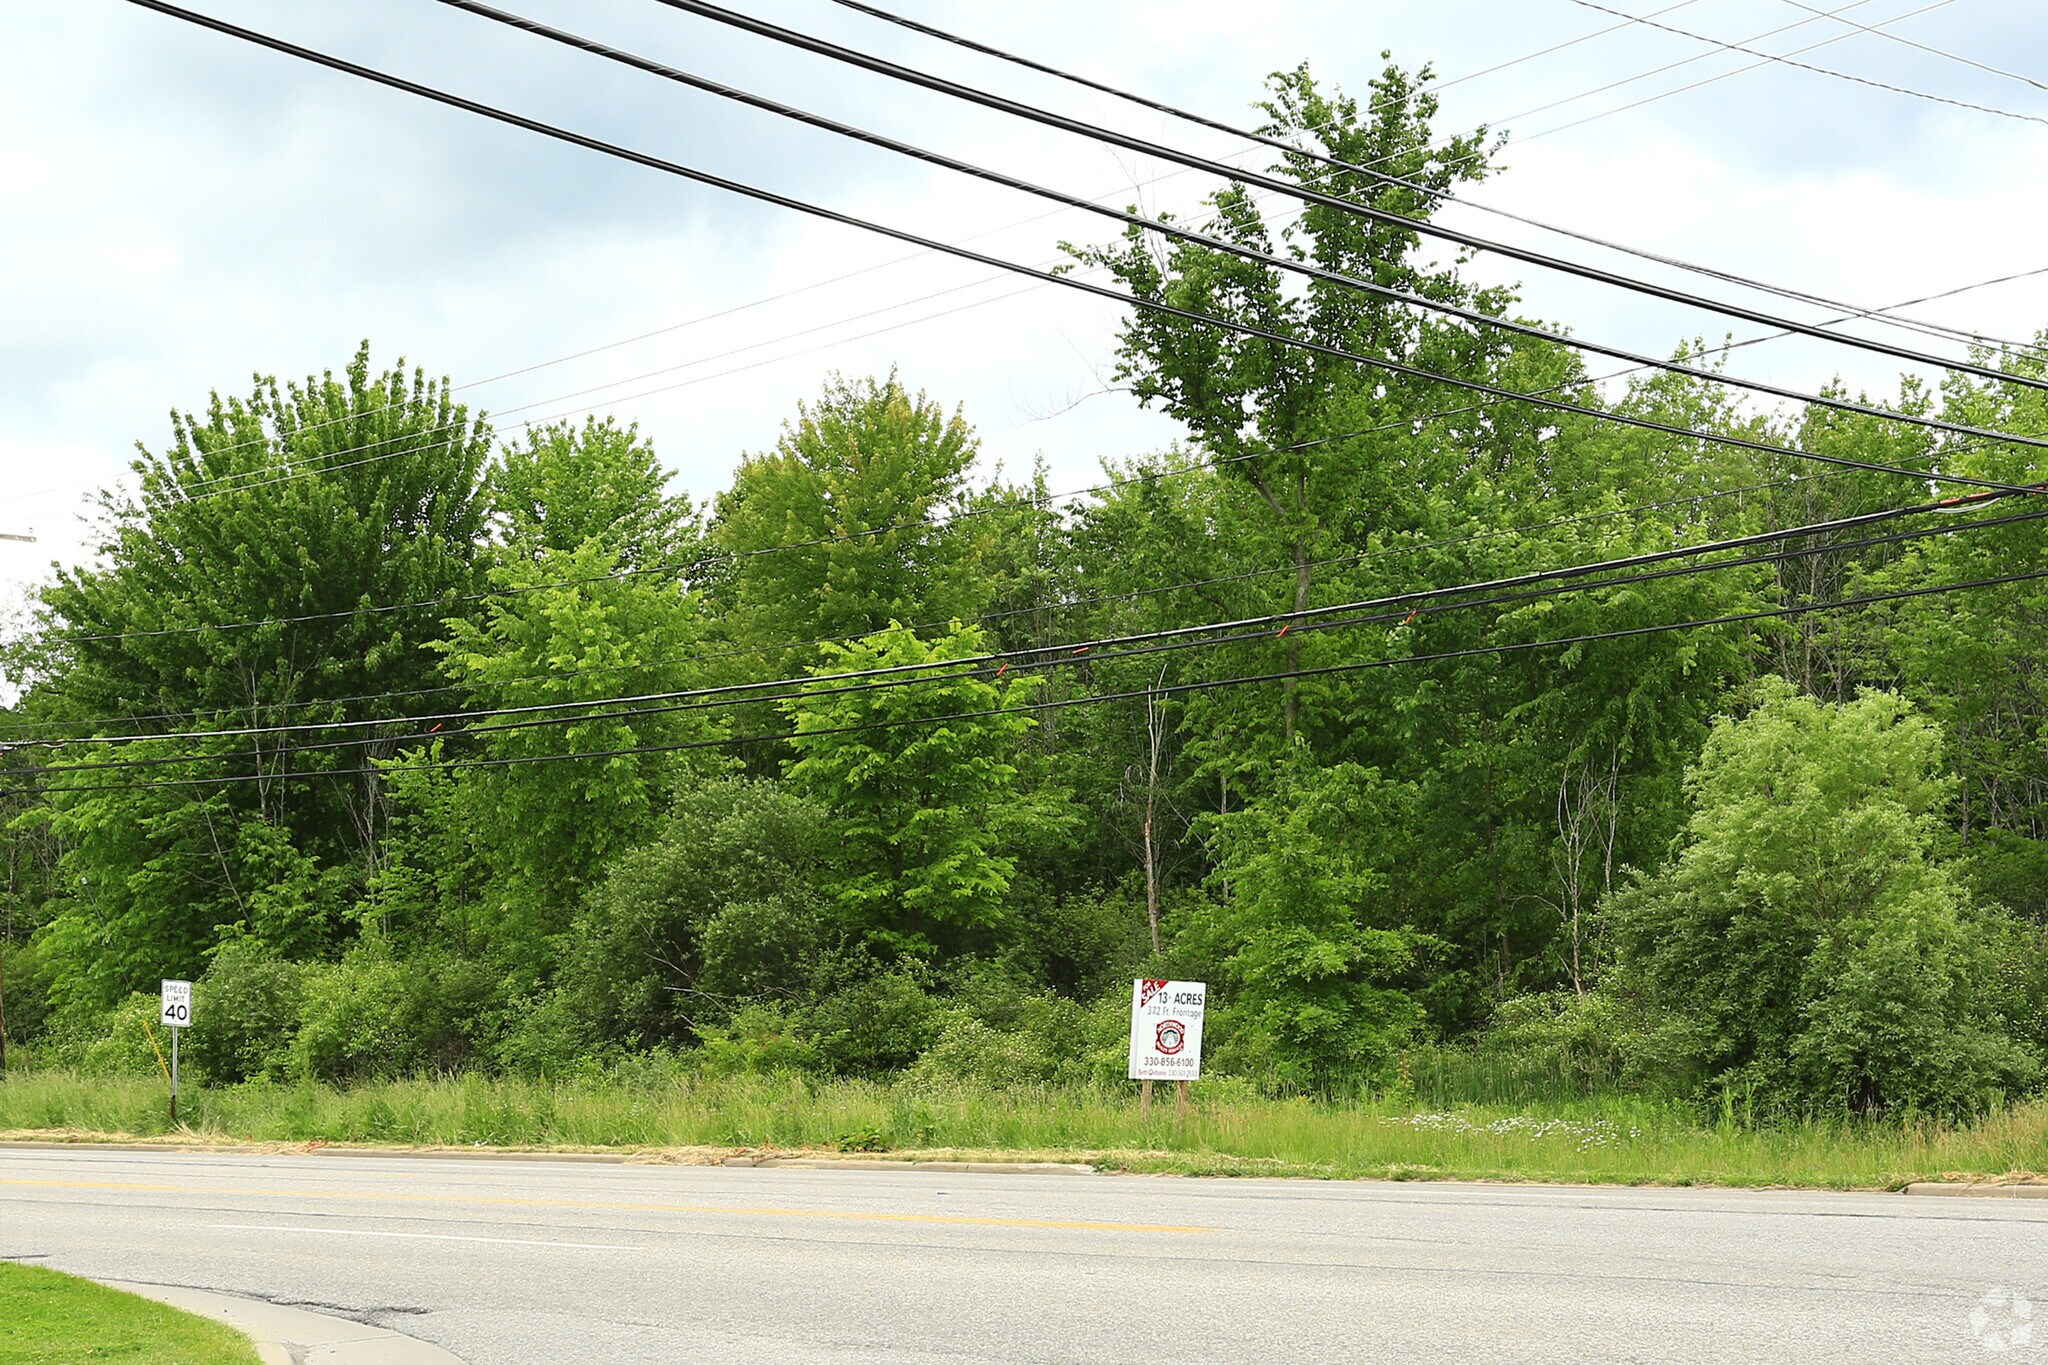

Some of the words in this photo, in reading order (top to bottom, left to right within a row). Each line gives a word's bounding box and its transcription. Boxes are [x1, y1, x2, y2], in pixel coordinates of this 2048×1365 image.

[164, 985, 188, 994] SPEED
[1141, 980, 1161, 1004] SALE
[1143, 981, 1152, 991] FOR
[1173, 992, 1203, 1006] ACRES
[164, 1004, 187, 1020] 40
[1147, 1005, 1161, 1016] 372
[1172, 1006, 1202, 1020] Frontage
[1143, 1056, 1195, 1067] 330-856-6100
